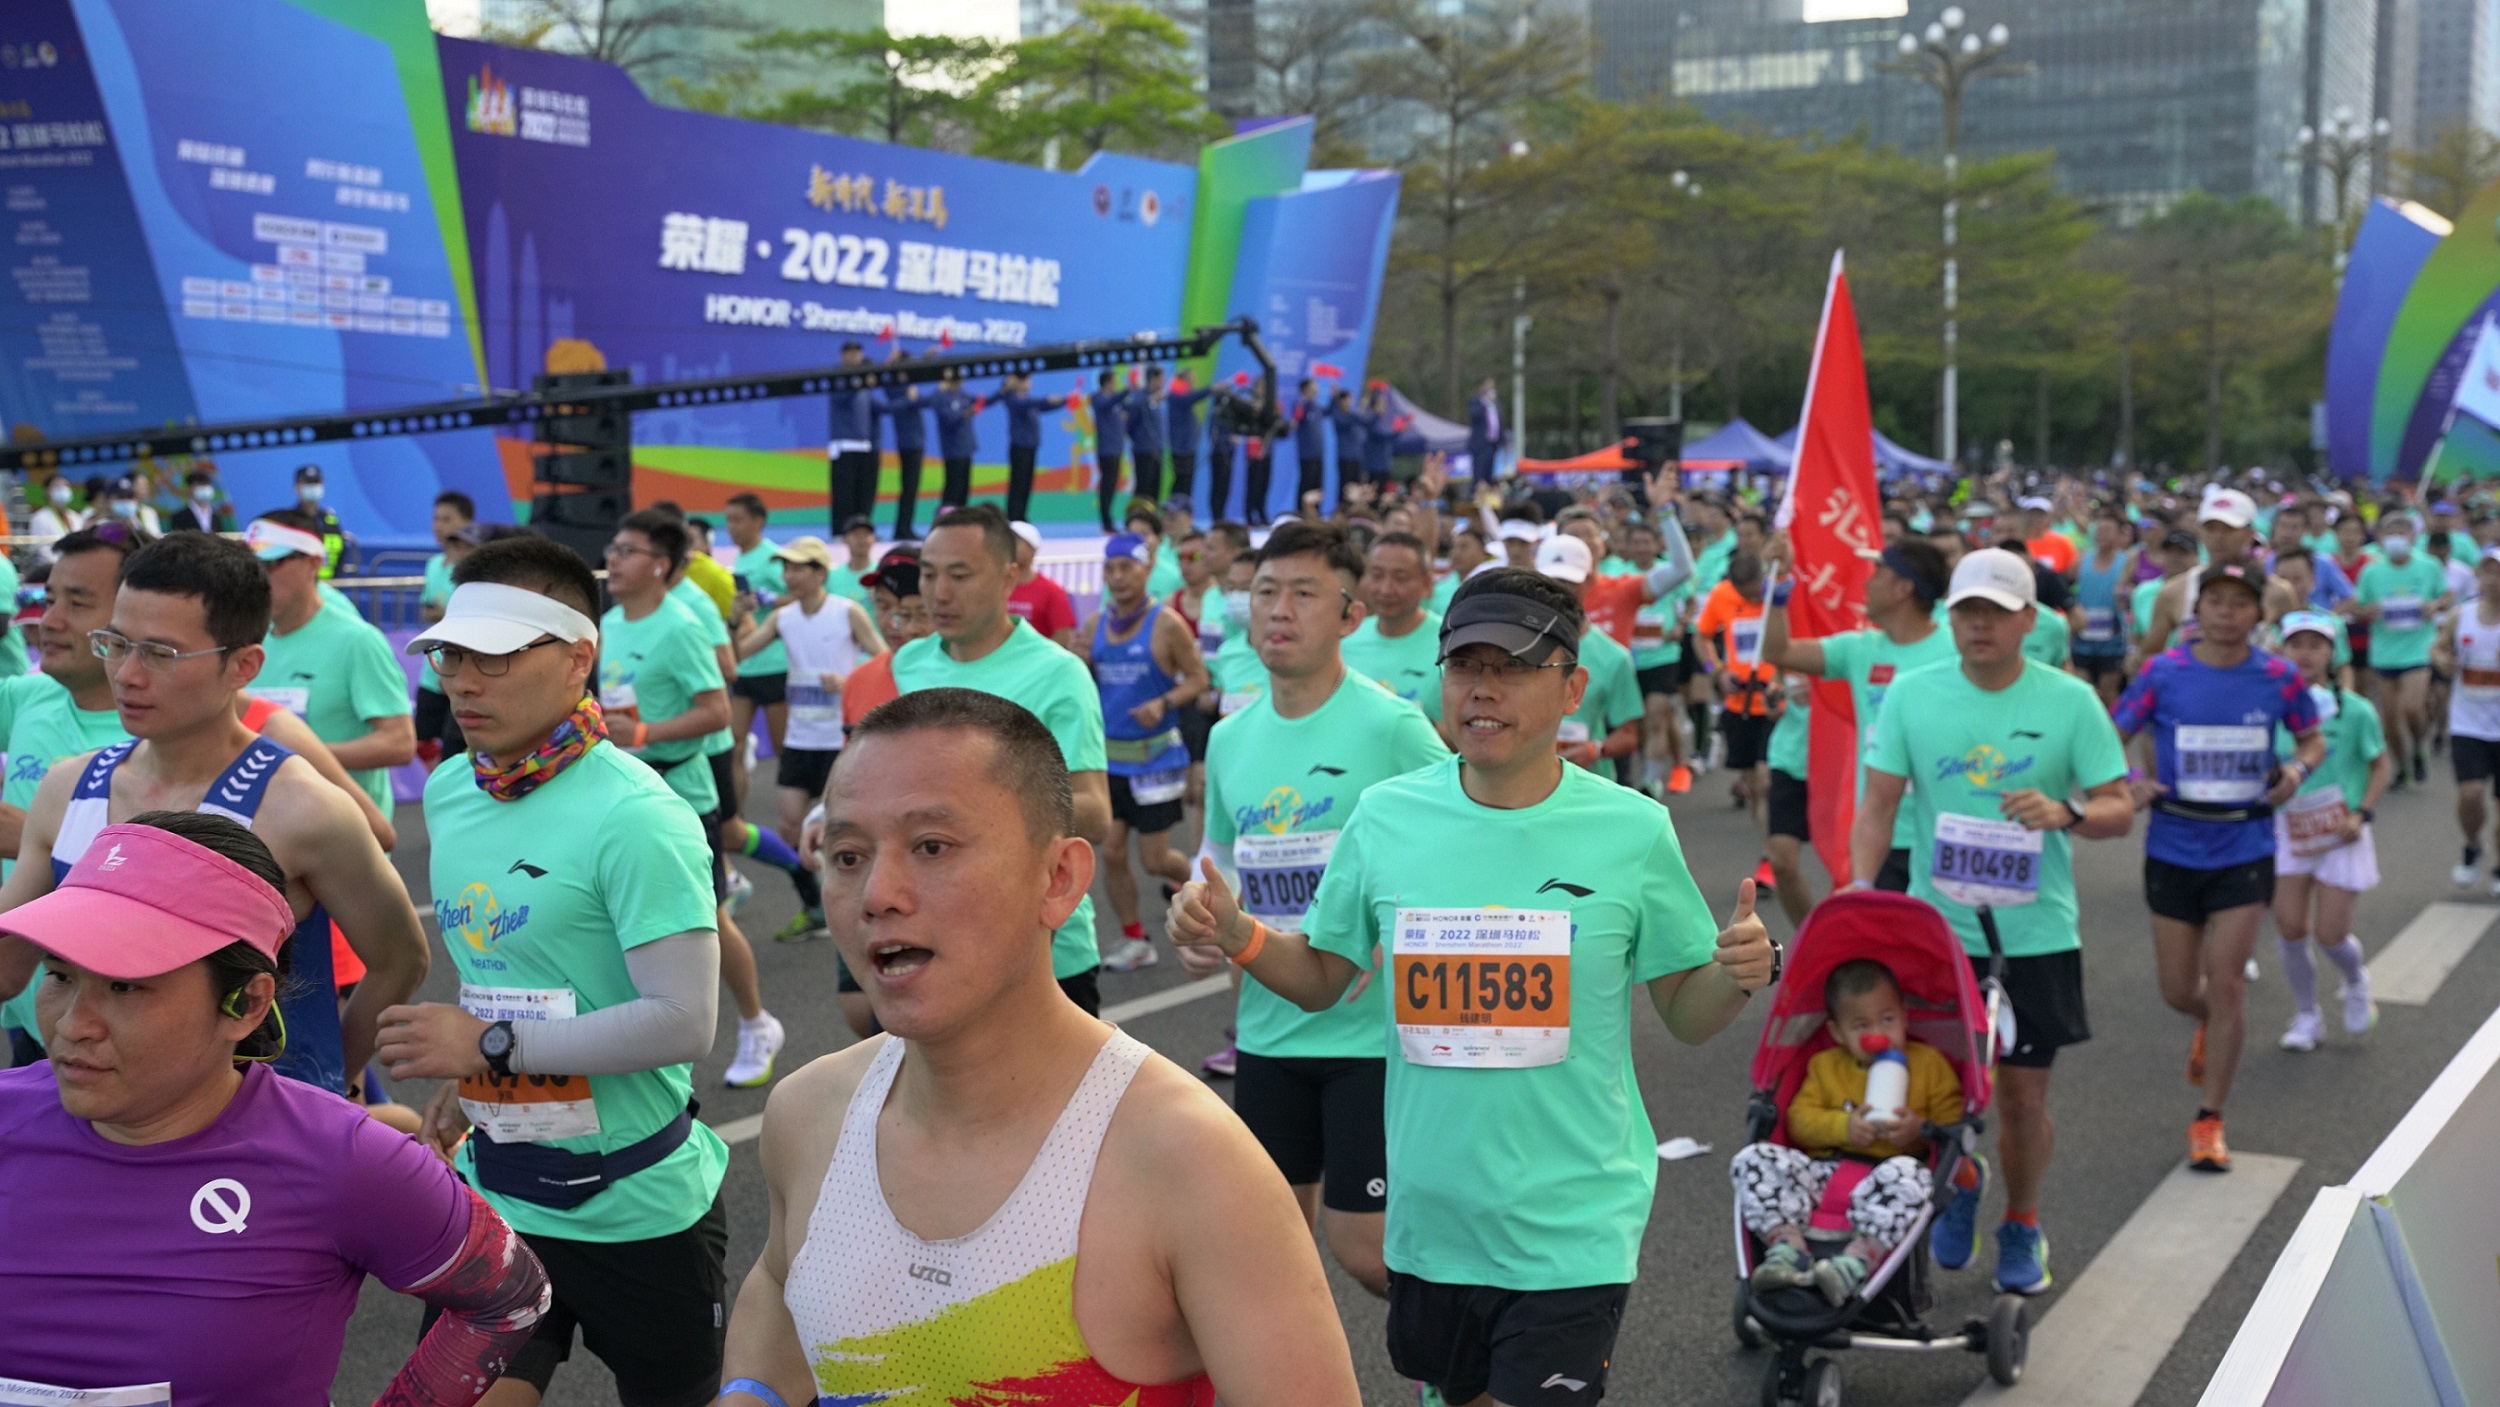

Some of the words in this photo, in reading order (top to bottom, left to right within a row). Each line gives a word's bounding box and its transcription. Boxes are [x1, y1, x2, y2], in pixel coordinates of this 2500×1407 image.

[658, 211, 750, 276] 荣耀
[780, 228, 890, 289] 2022
[894, 240, 1062, 308] 深圳马拉松
[705, 295, 792, 328] HONOR
[984, 318, 1027, 347] 2022
[1940, 845, 2032, 883] B10498
[1246, 868, 1325, 906] B1008
[1405, 929, 1426, 940] 荣耀
[1440, 929, 1471, 940] 2022
[1475, 929, 1541, 941] 深圳马拉松
[1435, 941, 1467, 949] Shenzhen
[1407, 961, 1554, 1012] C11583
[474, 1006, 494, 1019] 2022
[1459, 1012, 1493, 1025] 钱建明
[6, 1383, 57, 1397] Marathon
[58, 1389, 88, 1400] 2022
